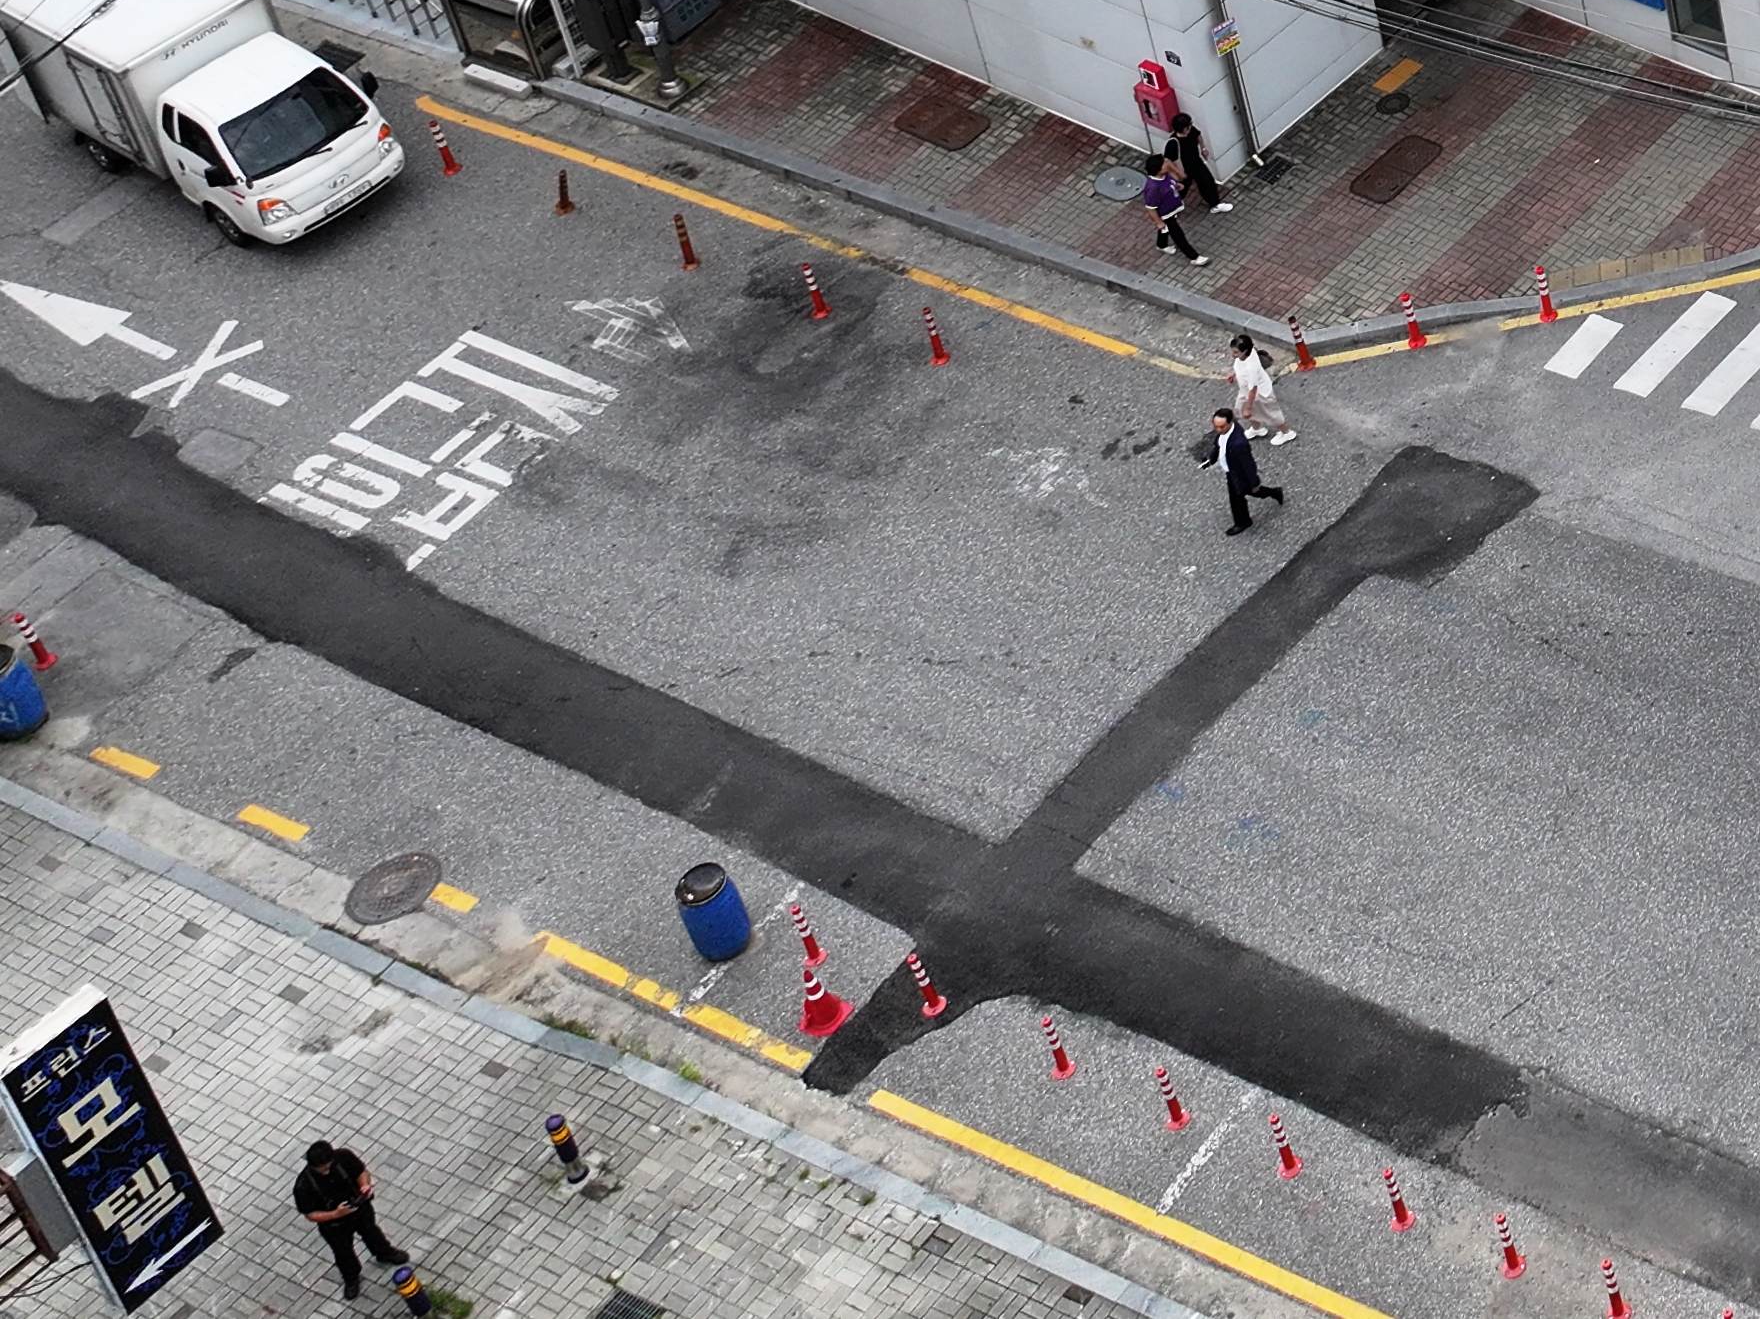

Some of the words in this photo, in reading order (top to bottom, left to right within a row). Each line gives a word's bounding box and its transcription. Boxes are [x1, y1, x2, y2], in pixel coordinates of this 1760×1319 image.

[181, 19, 228, 49] HYUNDAI
[21, 1025, 112, 1103] 프린스
[57, 1077, 186, 1245] 모텔
